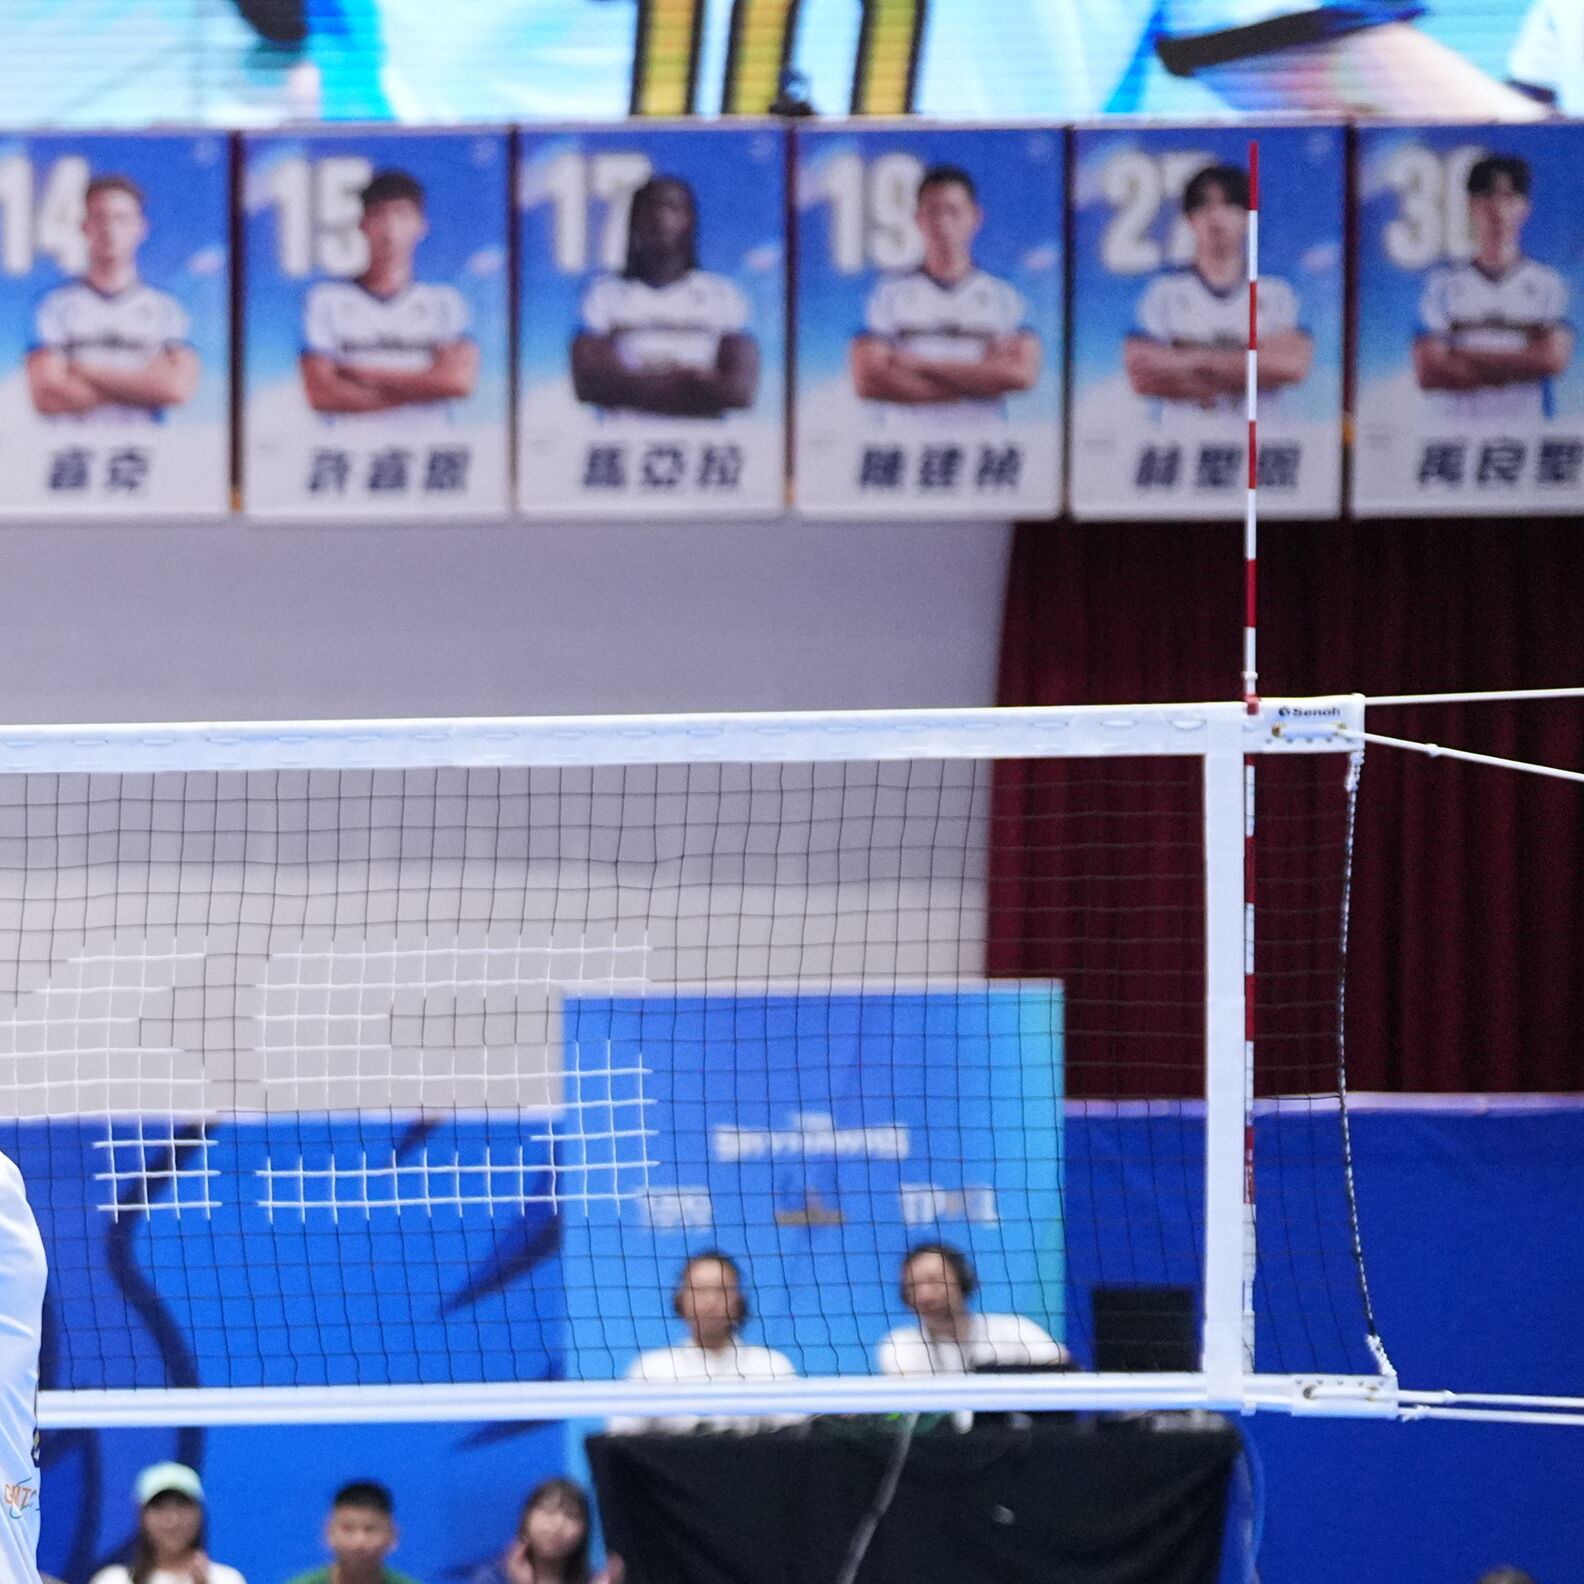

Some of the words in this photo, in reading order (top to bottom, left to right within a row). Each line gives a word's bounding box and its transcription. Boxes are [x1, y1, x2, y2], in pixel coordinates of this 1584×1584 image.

[268, 155, 374, 279] 15
[542, 152, 653, 275] 17
[826, 151, 925, 276] 19
